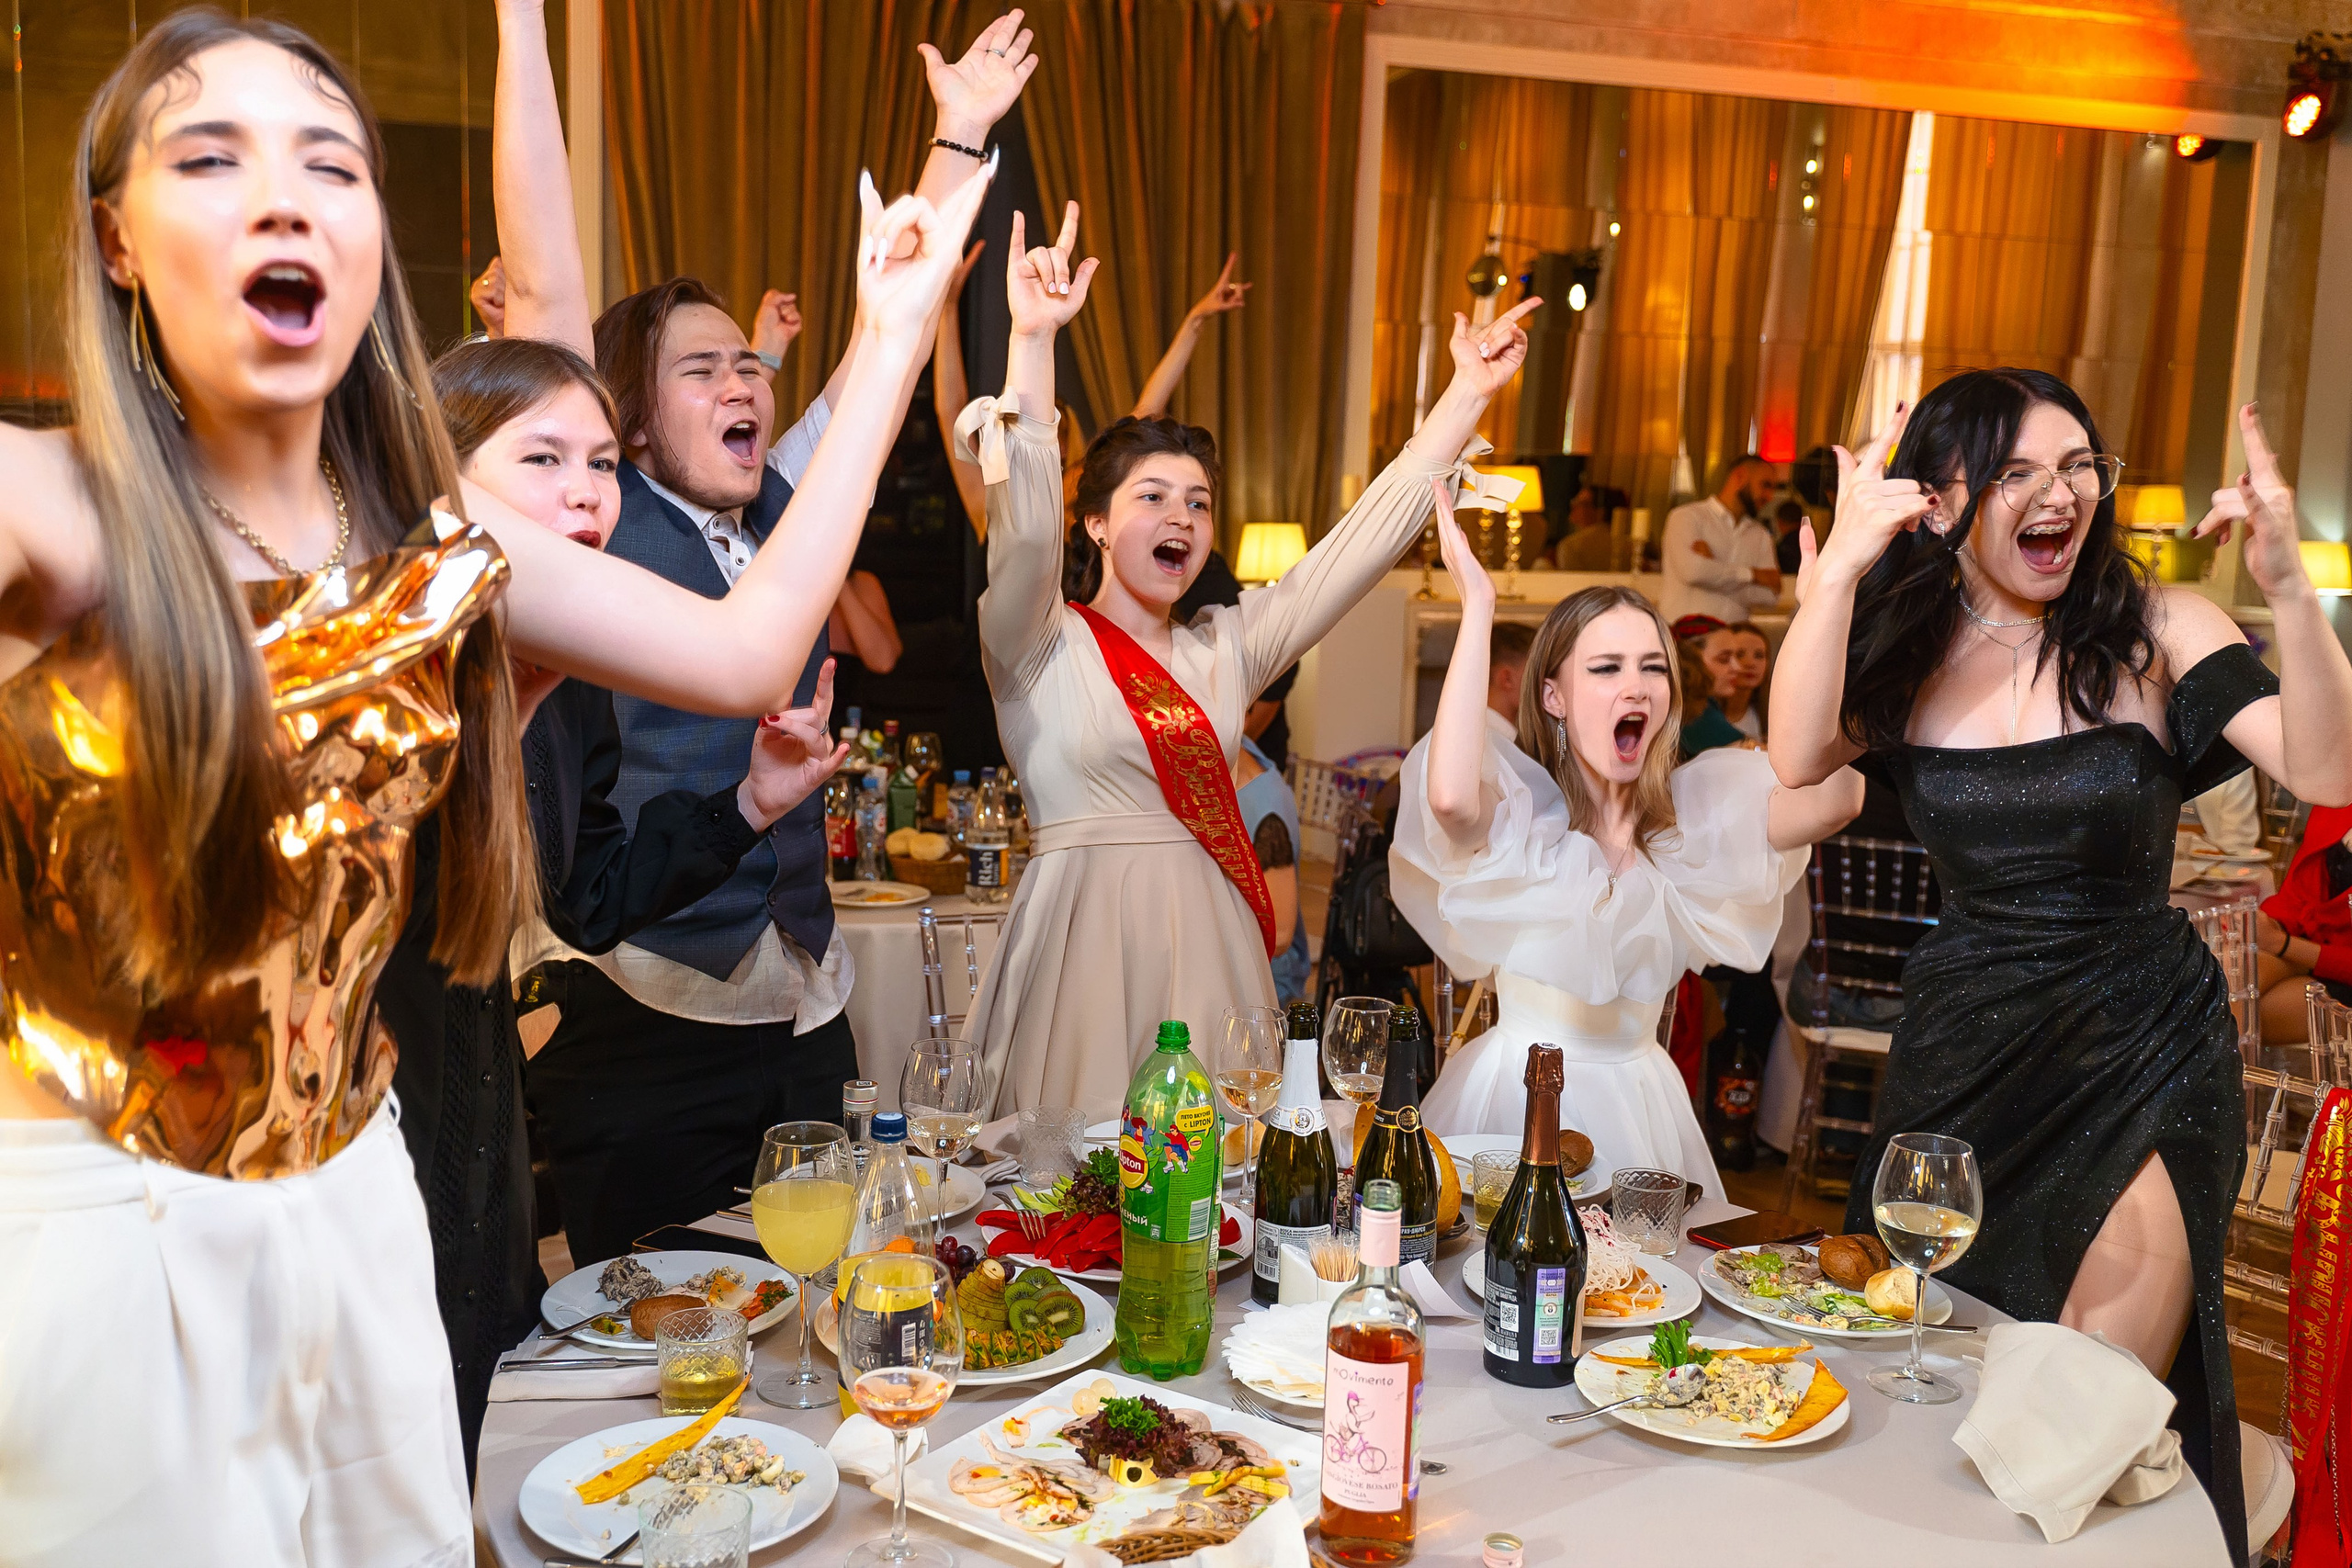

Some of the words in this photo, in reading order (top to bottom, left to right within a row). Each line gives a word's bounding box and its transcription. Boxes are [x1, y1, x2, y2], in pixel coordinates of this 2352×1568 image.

[978, 852, 994, 886] Rich
[1189, 1117, 1212, 1128] LIPTON
[1366, 1482, 1398, 1490] ROSATO
